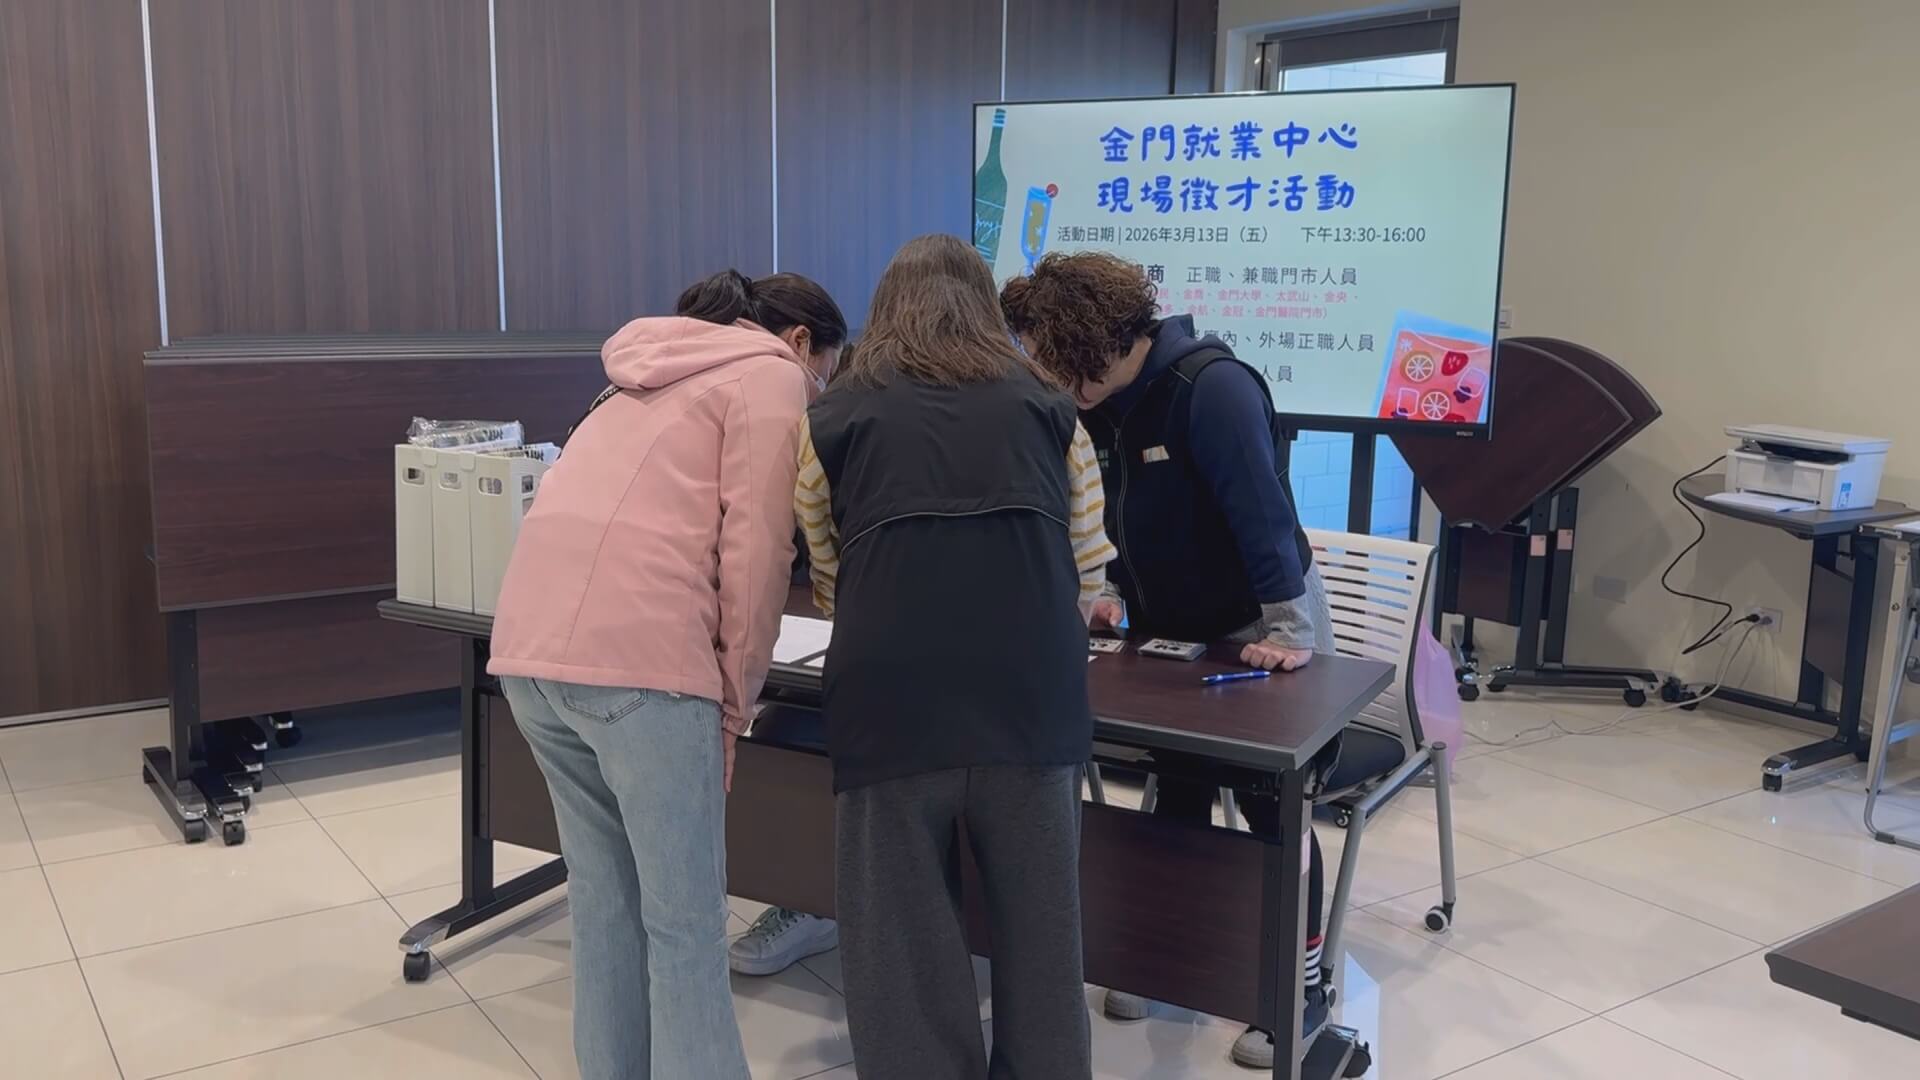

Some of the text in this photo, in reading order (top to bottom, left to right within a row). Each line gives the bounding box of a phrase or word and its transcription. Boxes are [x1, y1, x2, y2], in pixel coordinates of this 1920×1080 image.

[1099, 120, 1358, 162] 金門就業中心
[1097, 174, 1355, 214] 現場徵才活動
[1301, 225, 1426, 243] 下午13:30-16:00
